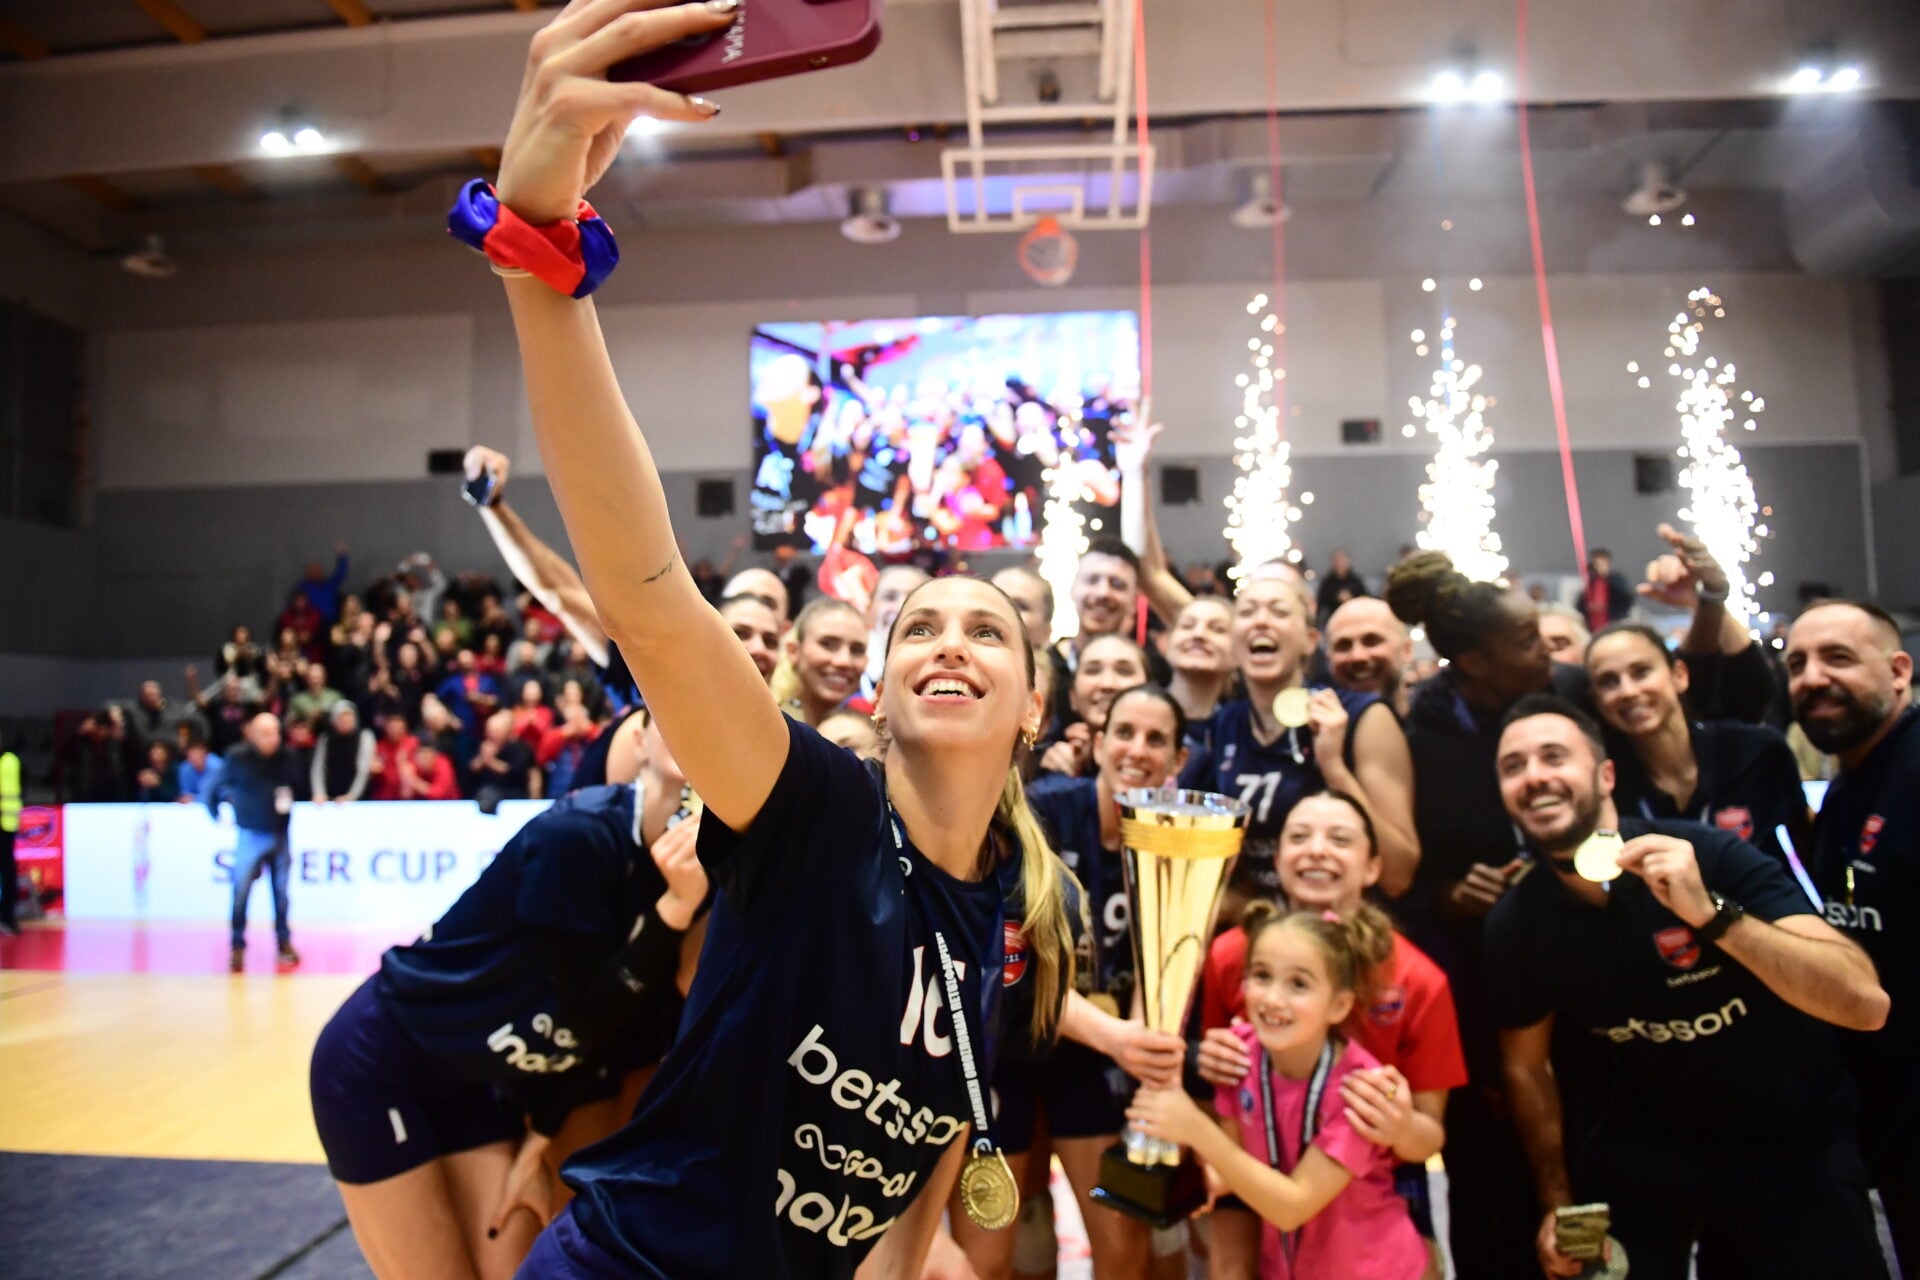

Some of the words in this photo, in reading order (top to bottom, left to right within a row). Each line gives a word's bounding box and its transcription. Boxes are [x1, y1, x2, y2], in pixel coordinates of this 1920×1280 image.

[212, 850, 351, 883] SER
[370, 850, 457, 883] CUP
[1605, 998, 1748, 1043] etsson
[787, 1024, 970, 1145] betsso
